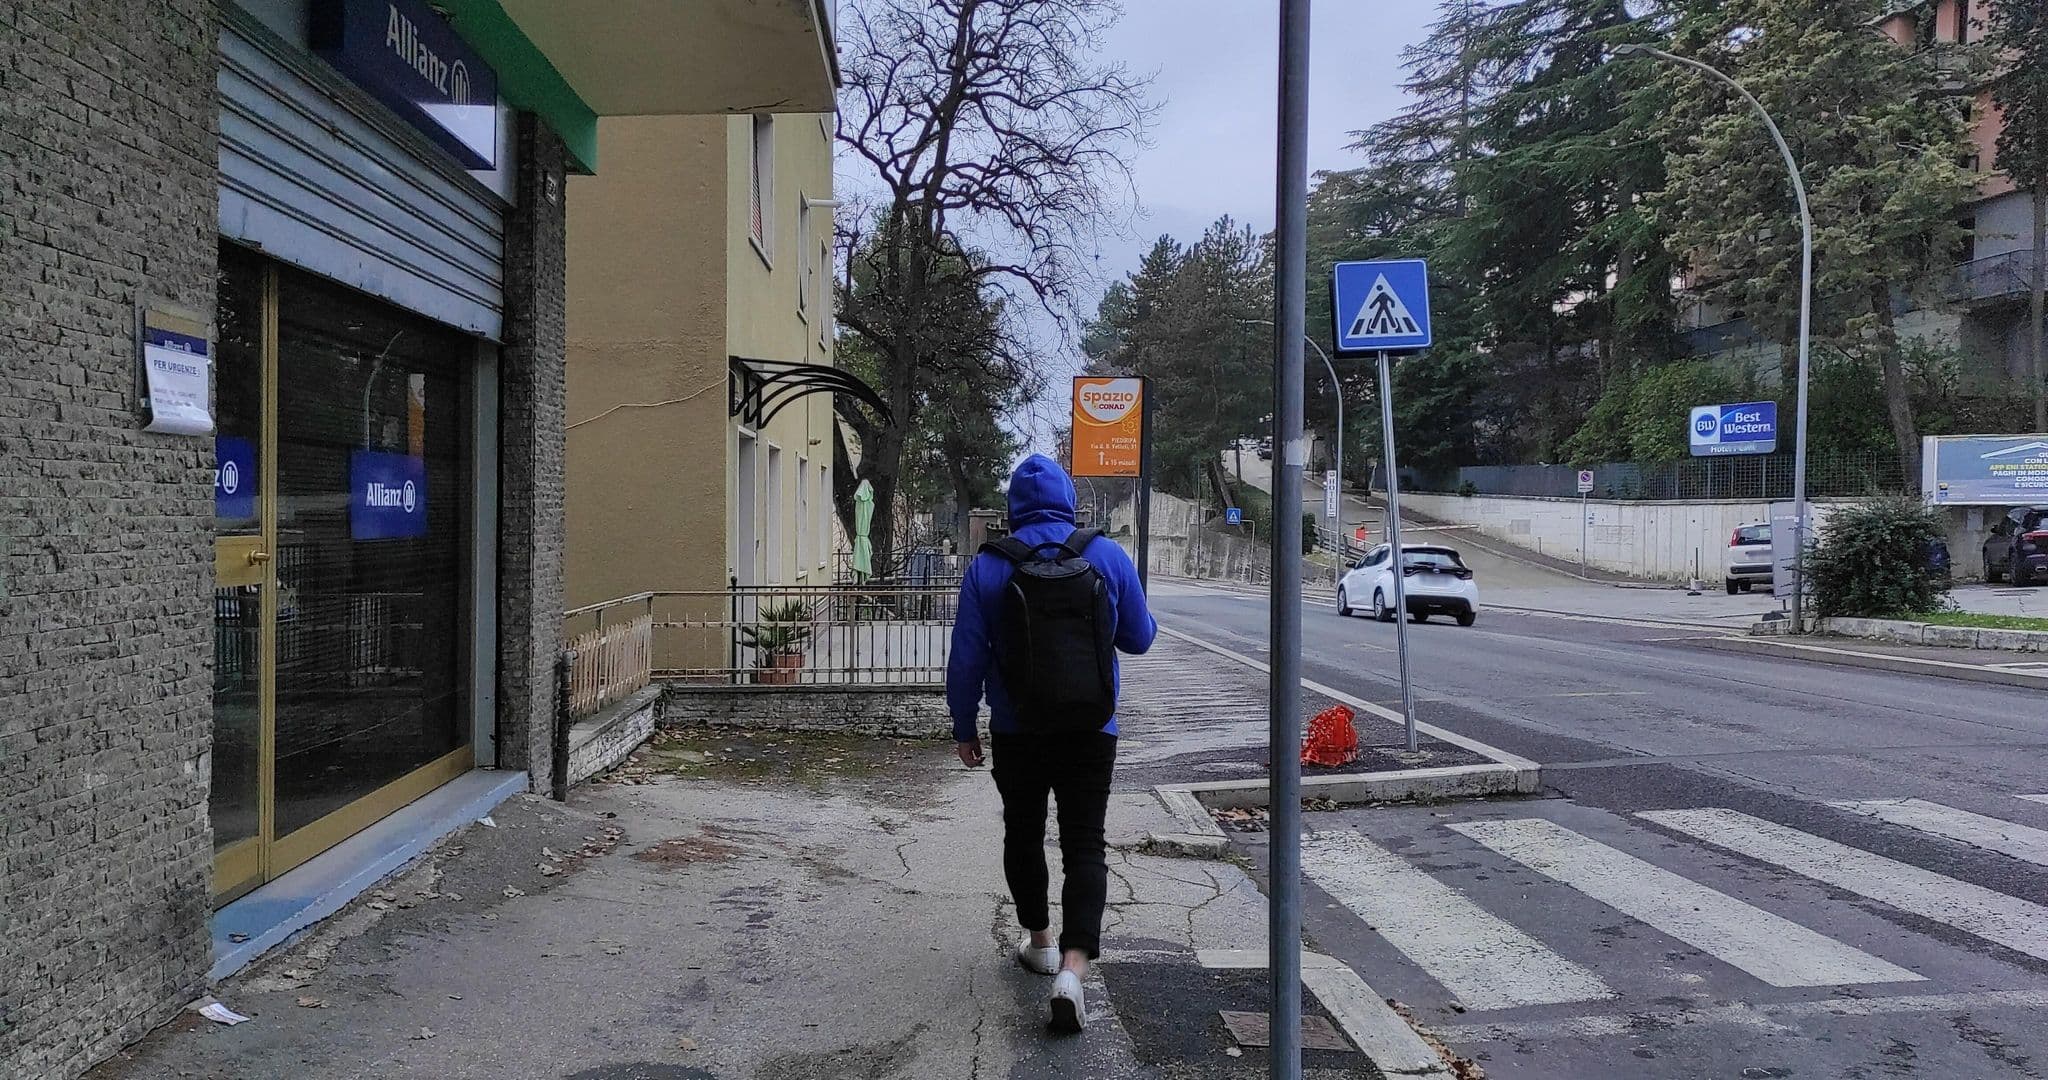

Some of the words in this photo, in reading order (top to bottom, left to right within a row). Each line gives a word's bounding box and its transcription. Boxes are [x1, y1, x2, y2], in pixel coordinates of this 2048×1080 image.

[386, 3, 448, 96] Allianz
[153, 359, 166, 370] PER
[1083, 391, 1134, 405] spazio
[1735, 411, 1761, 423] Best
[1697, 420, 1715, 431] BW
[1724, 423, 1771, 434] Western
[366, 482, 402, 507] Allianz
